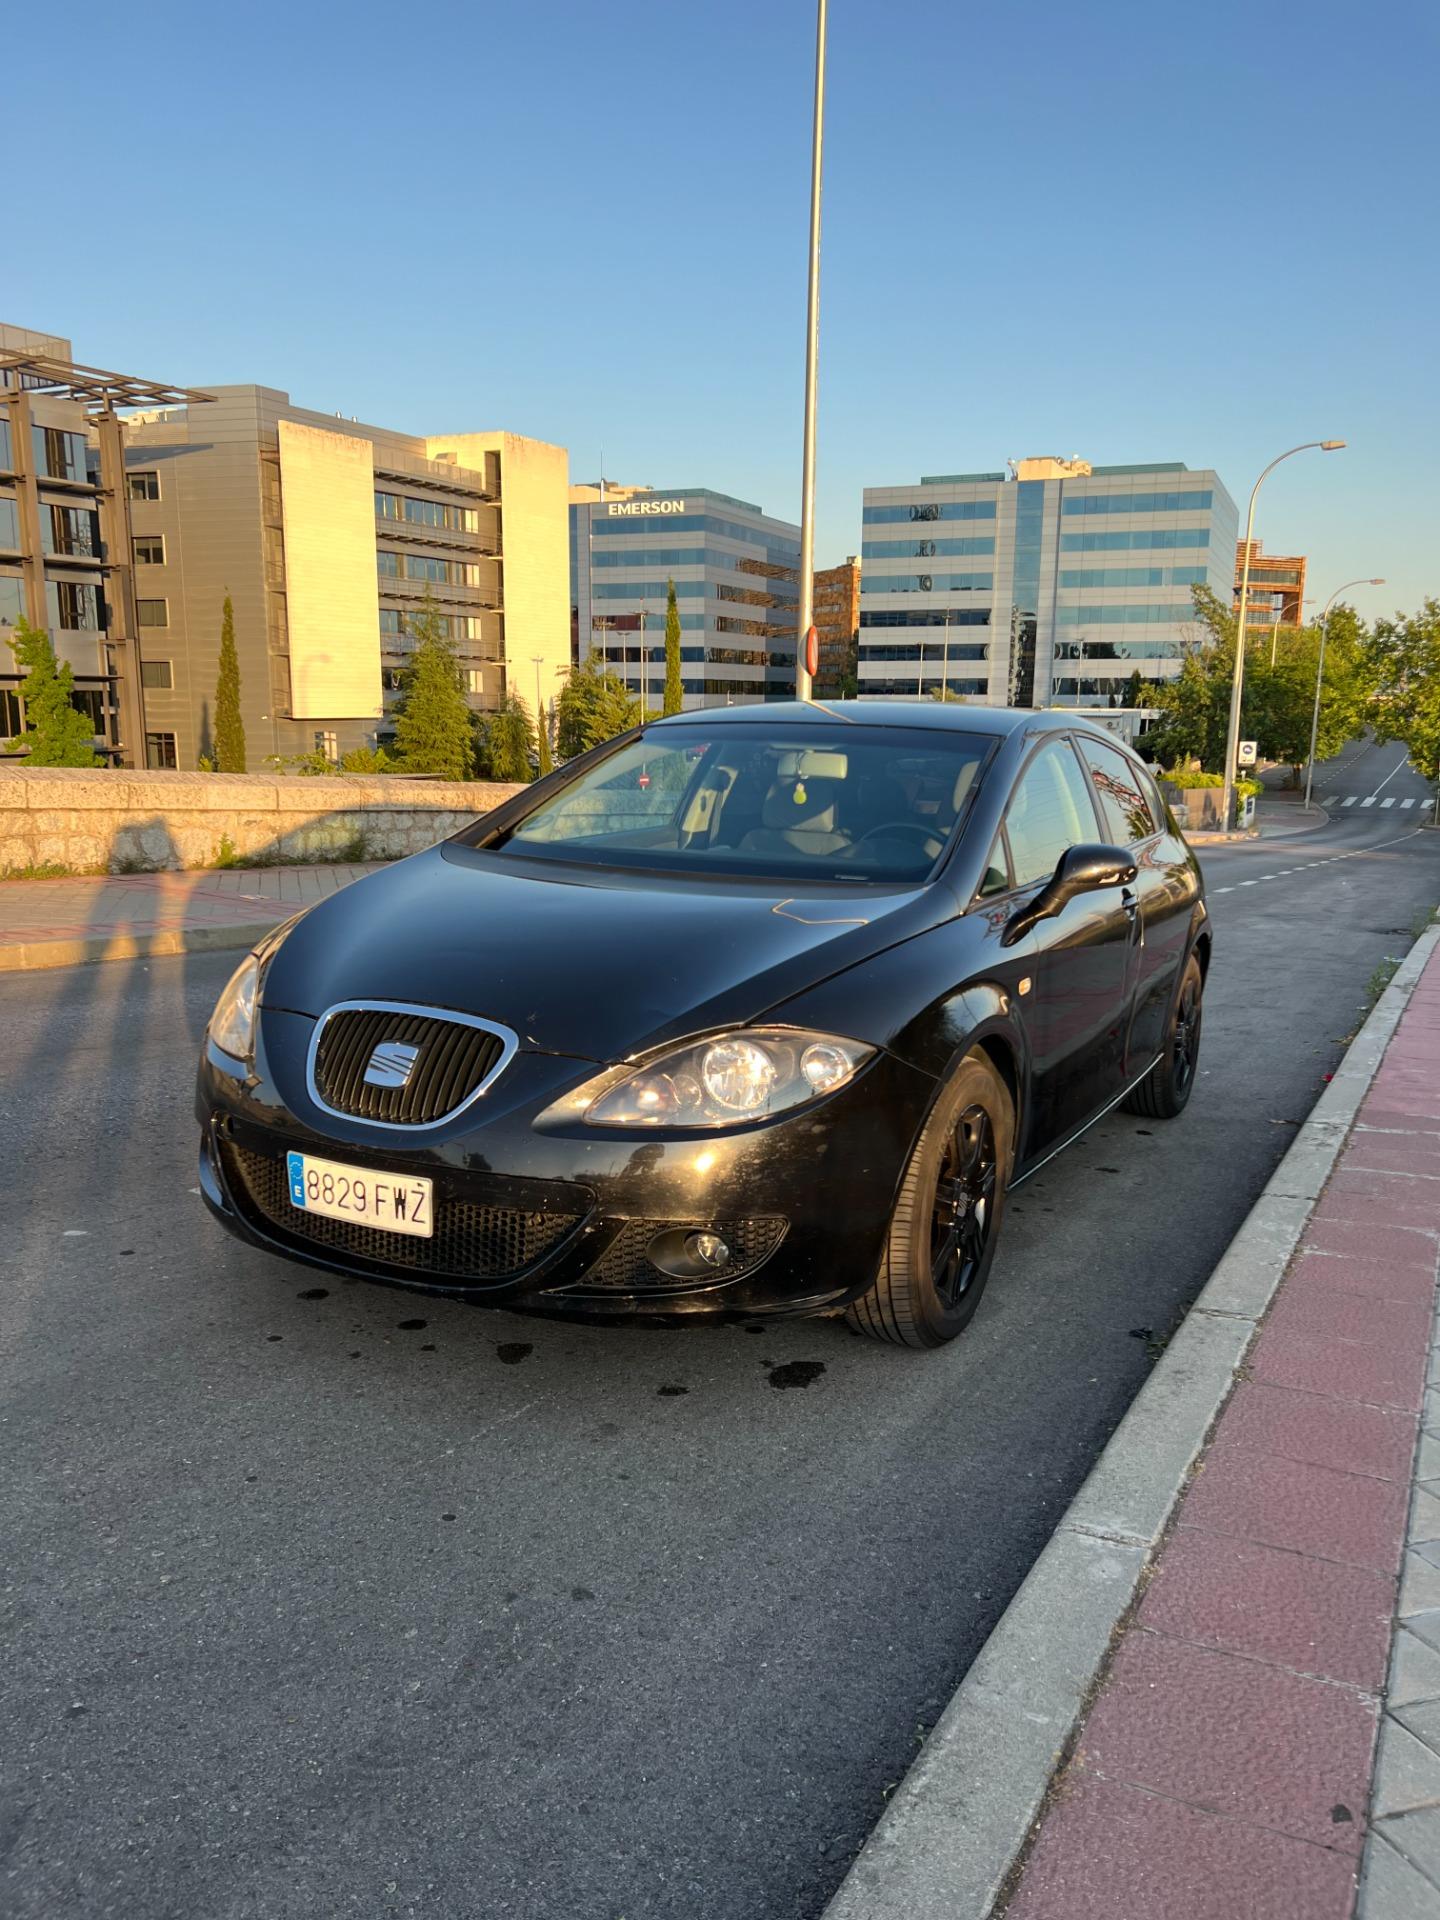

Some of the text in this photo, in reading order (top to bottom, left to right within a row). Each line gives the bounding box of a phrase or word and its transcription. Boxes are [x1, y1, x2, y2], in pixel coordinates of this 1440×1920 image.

[608, 500, 685, 516] EMERSON
[294, 1169, 426, 1224] E 8829 FWZ
